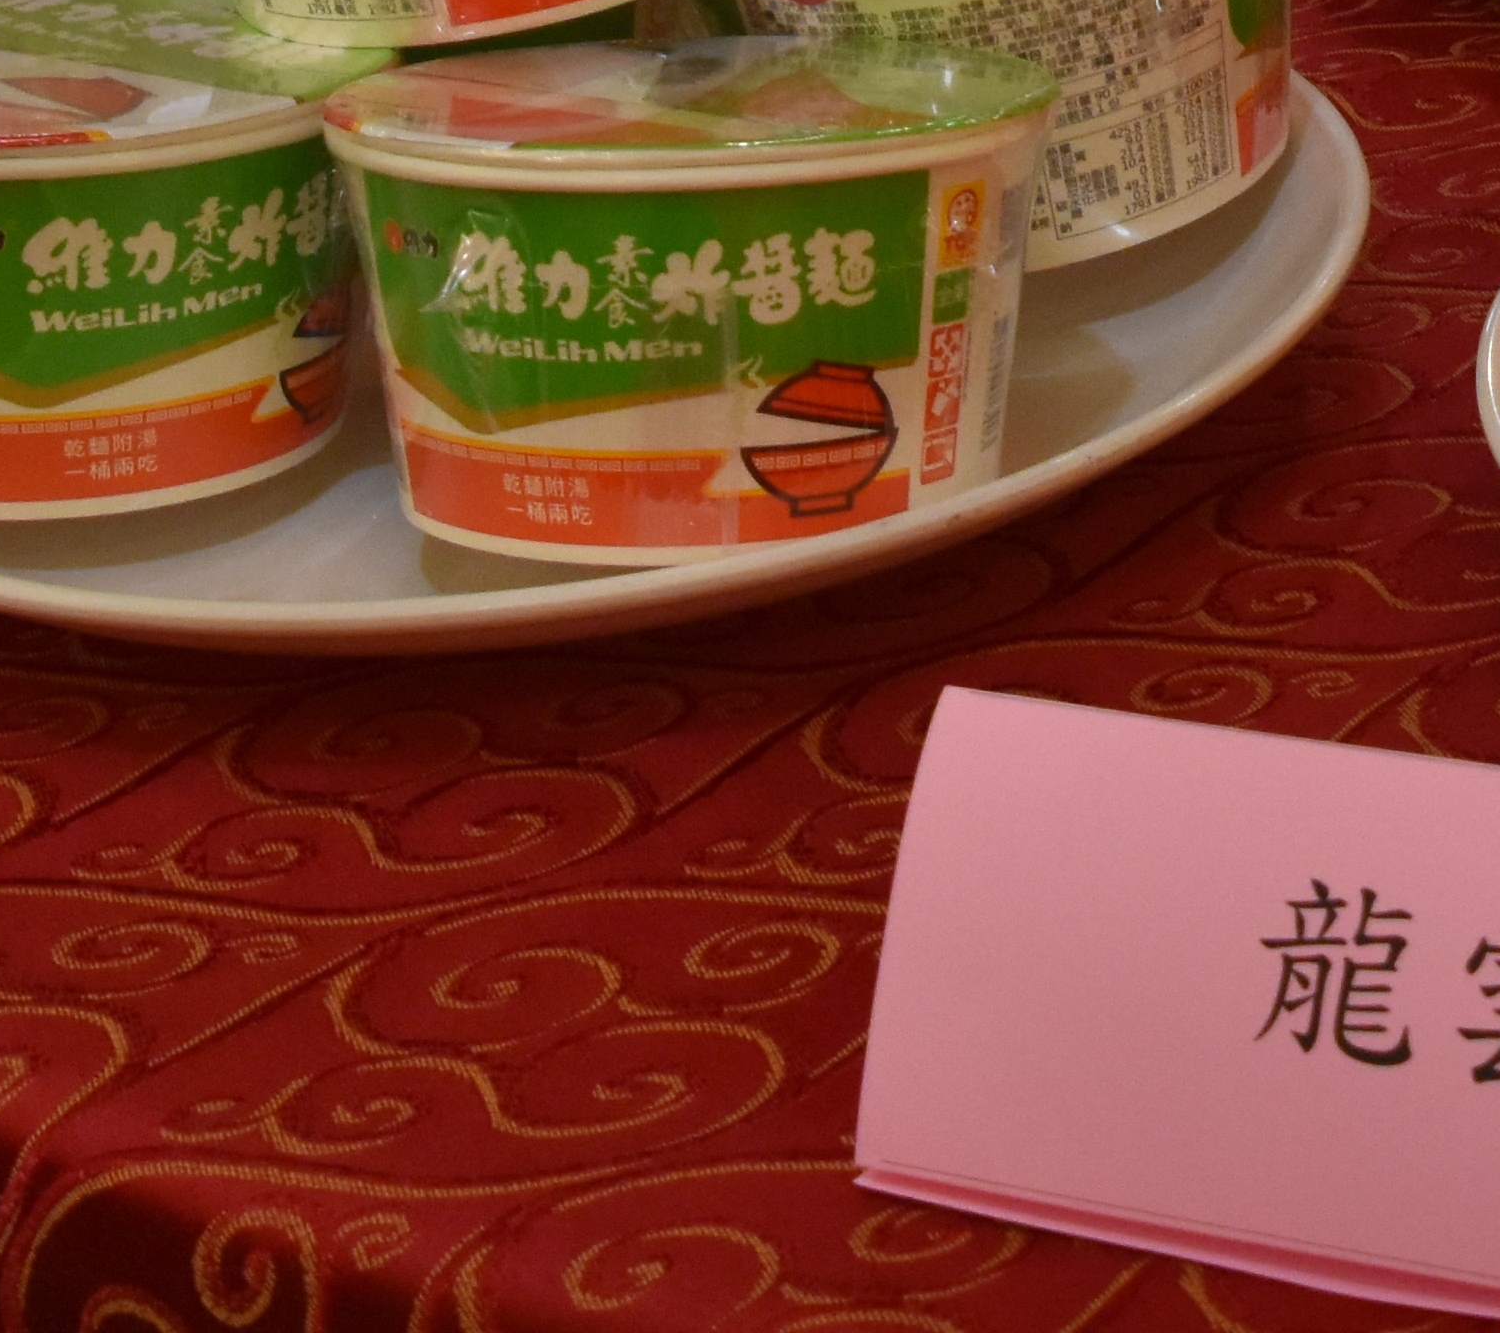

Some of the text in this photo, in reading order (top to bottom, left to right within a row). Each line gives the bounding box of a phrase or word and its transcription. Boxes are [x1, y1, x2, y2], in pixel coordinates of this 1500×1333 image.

[29, 279, 263, 334] WeiLih Men
[463, 330, 704, 363] WeiLih Men
[62, 429, 158, 458] 乾麵附湯
[62, 454, 159, 480] 一桶兩吃
[502, 471, 591, 501] 乾麵附湯
[504, 498, 594, 527] 一桶兩吃
